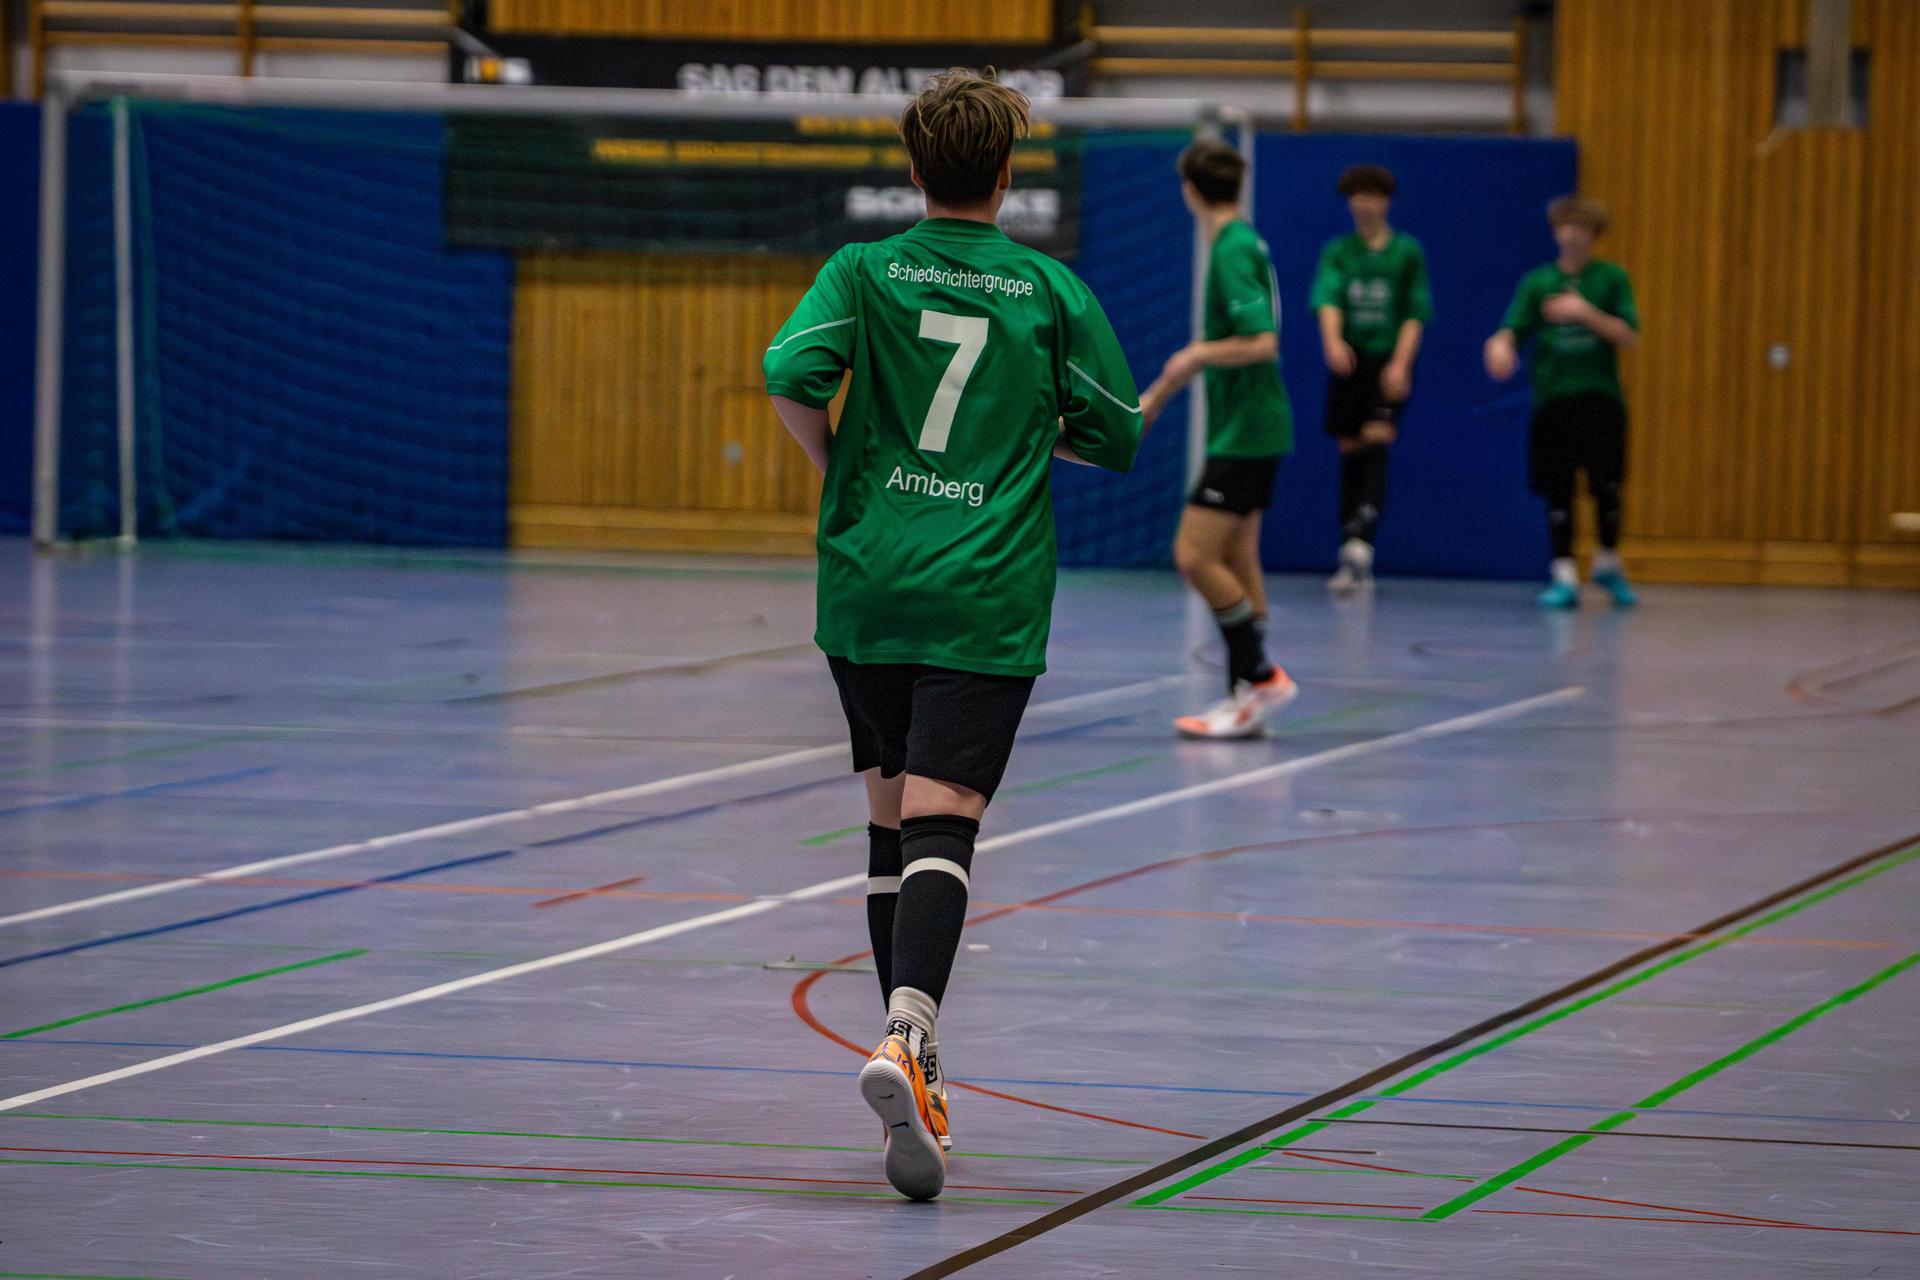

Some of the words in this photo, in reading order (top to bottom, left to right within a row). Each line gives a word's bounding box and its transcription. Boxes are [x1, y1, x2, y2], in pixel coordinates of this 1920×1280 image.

[887, 262, 1034, 298] Schiedsrichtergruppe
[917, 309, 990, 453] 7
[885, 465, 985, 507] Amberg
